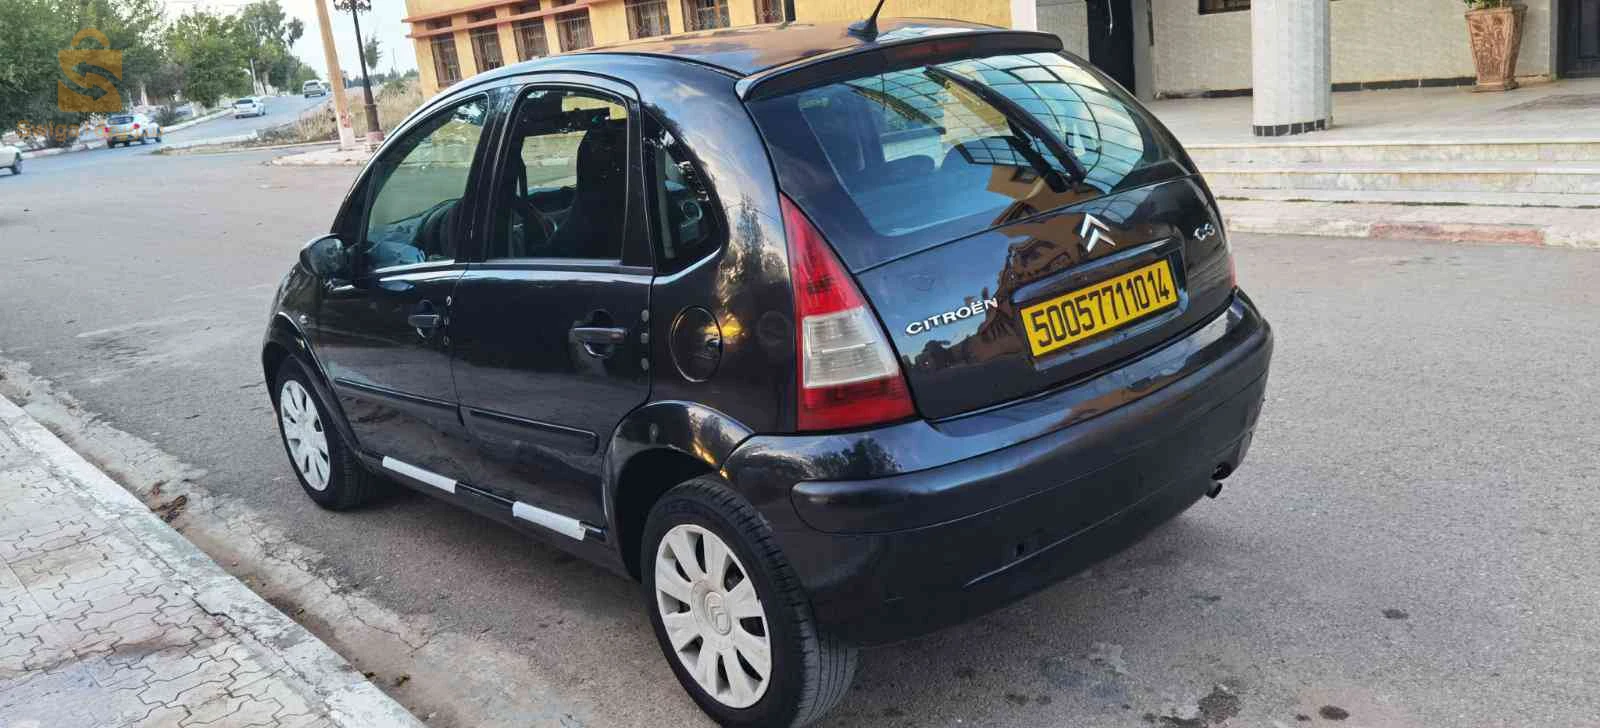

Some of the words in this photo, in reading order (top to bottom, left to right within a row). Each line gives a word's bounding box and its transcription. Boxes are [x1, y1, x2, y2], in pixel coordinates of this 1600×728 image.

[1194, 223, 1215, 240] C3
[905, 297, 998, 334] CITROËN
[1030, 267, 1170, 347] 50057711014
